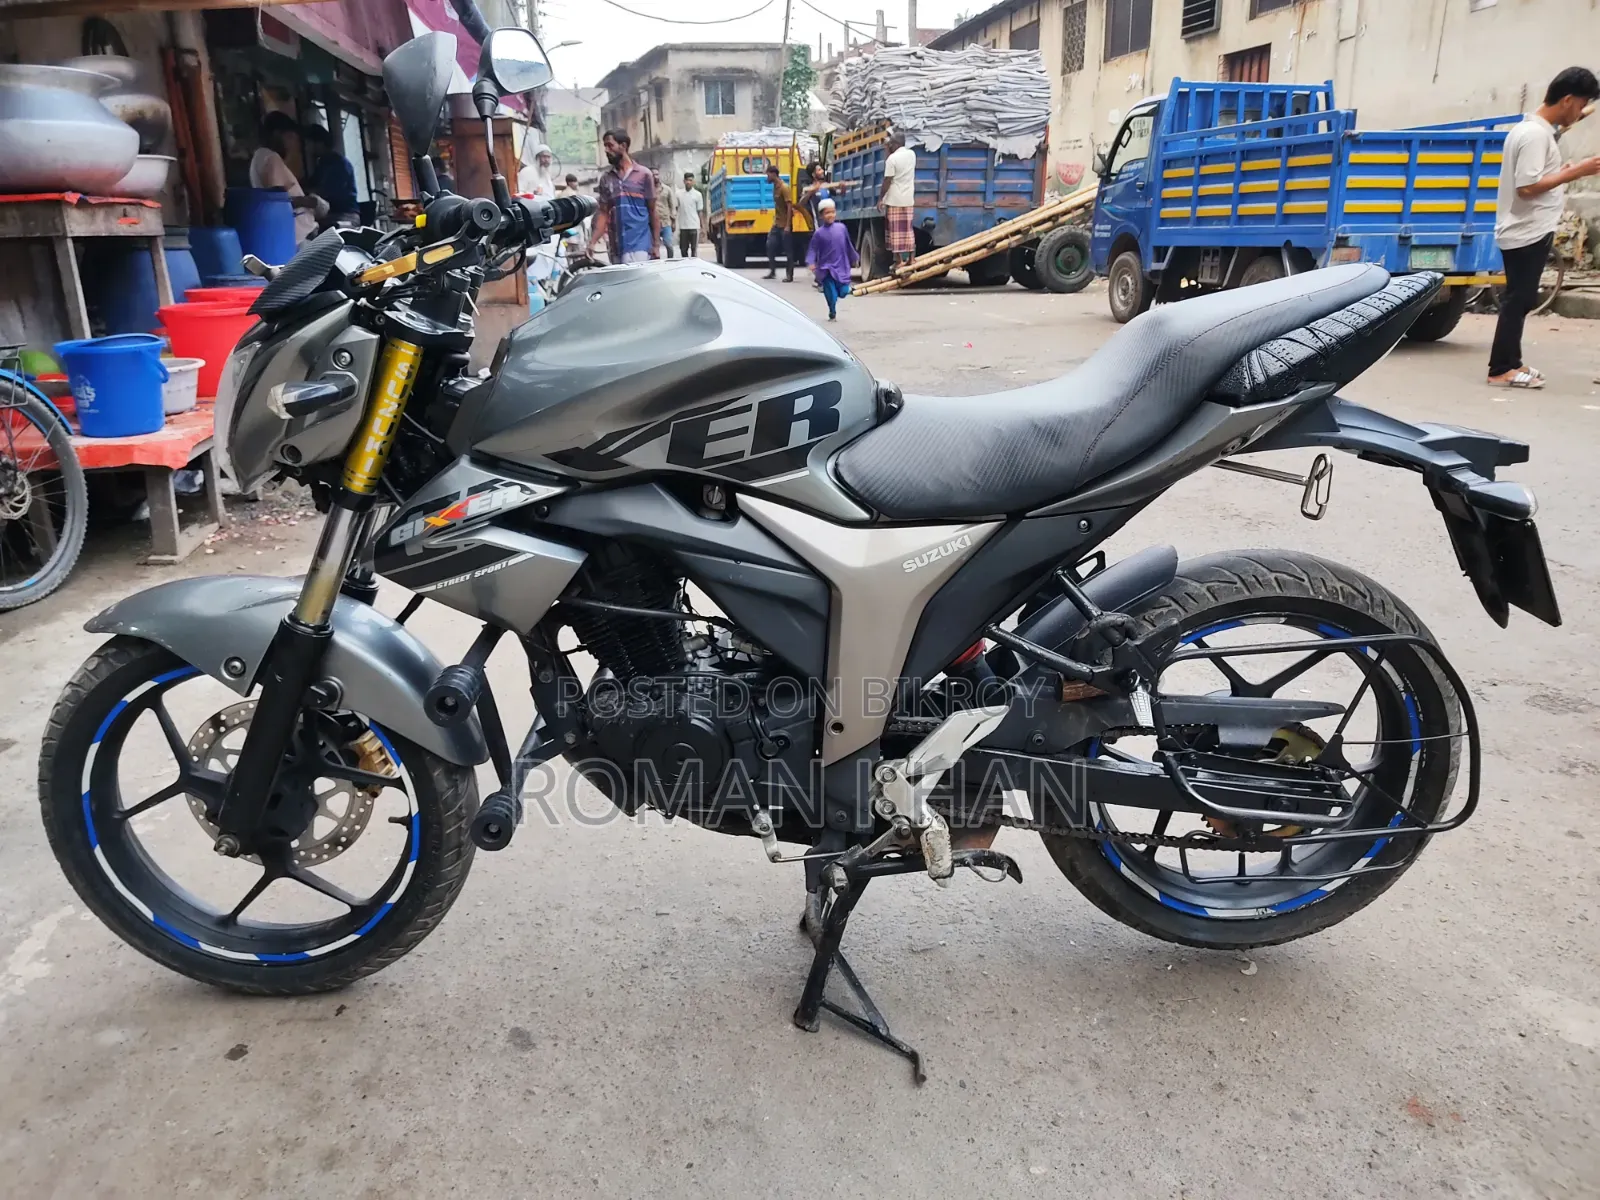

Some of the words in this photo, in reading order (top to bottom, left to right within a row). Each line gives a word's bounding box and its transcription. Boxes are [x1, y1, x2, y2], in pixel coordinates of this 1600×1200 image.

[364, 361, 415, 472] SUZUKI
[902, 534, 972, 573] SUZUKI
[436, 573, 472, 589] STREET
[473, 560, 508, 578] SPORT
